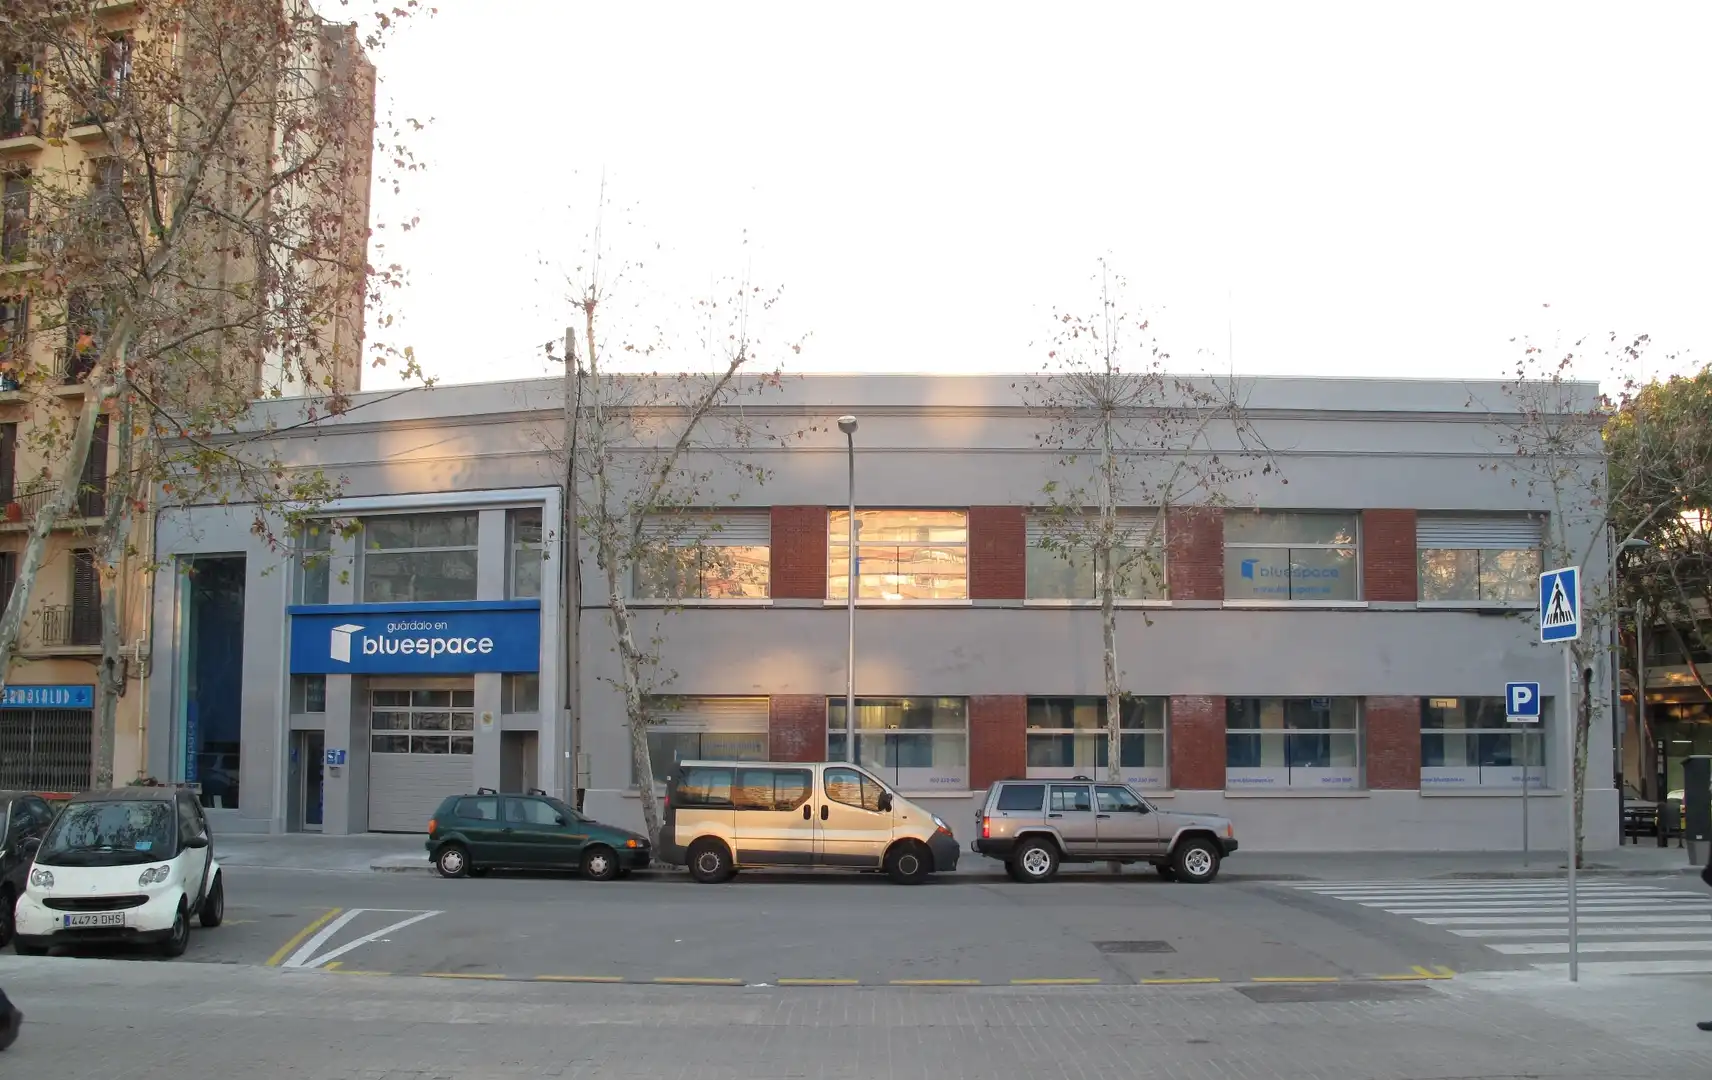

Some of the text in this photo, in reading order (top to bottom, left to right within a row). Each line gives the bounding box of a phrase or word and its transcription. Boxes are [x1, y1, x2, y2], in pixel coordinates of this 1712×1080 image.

[1261, 566, 1339, 579] bluespace
[387, 620, 448, 633] guárdalo en
[362, 635, 494, 659] bluespace
[1, 688, 70, 704] ARMASALUD
[1512, 686, 1532, 712] P
[101, 914, 121, 924] DHS
